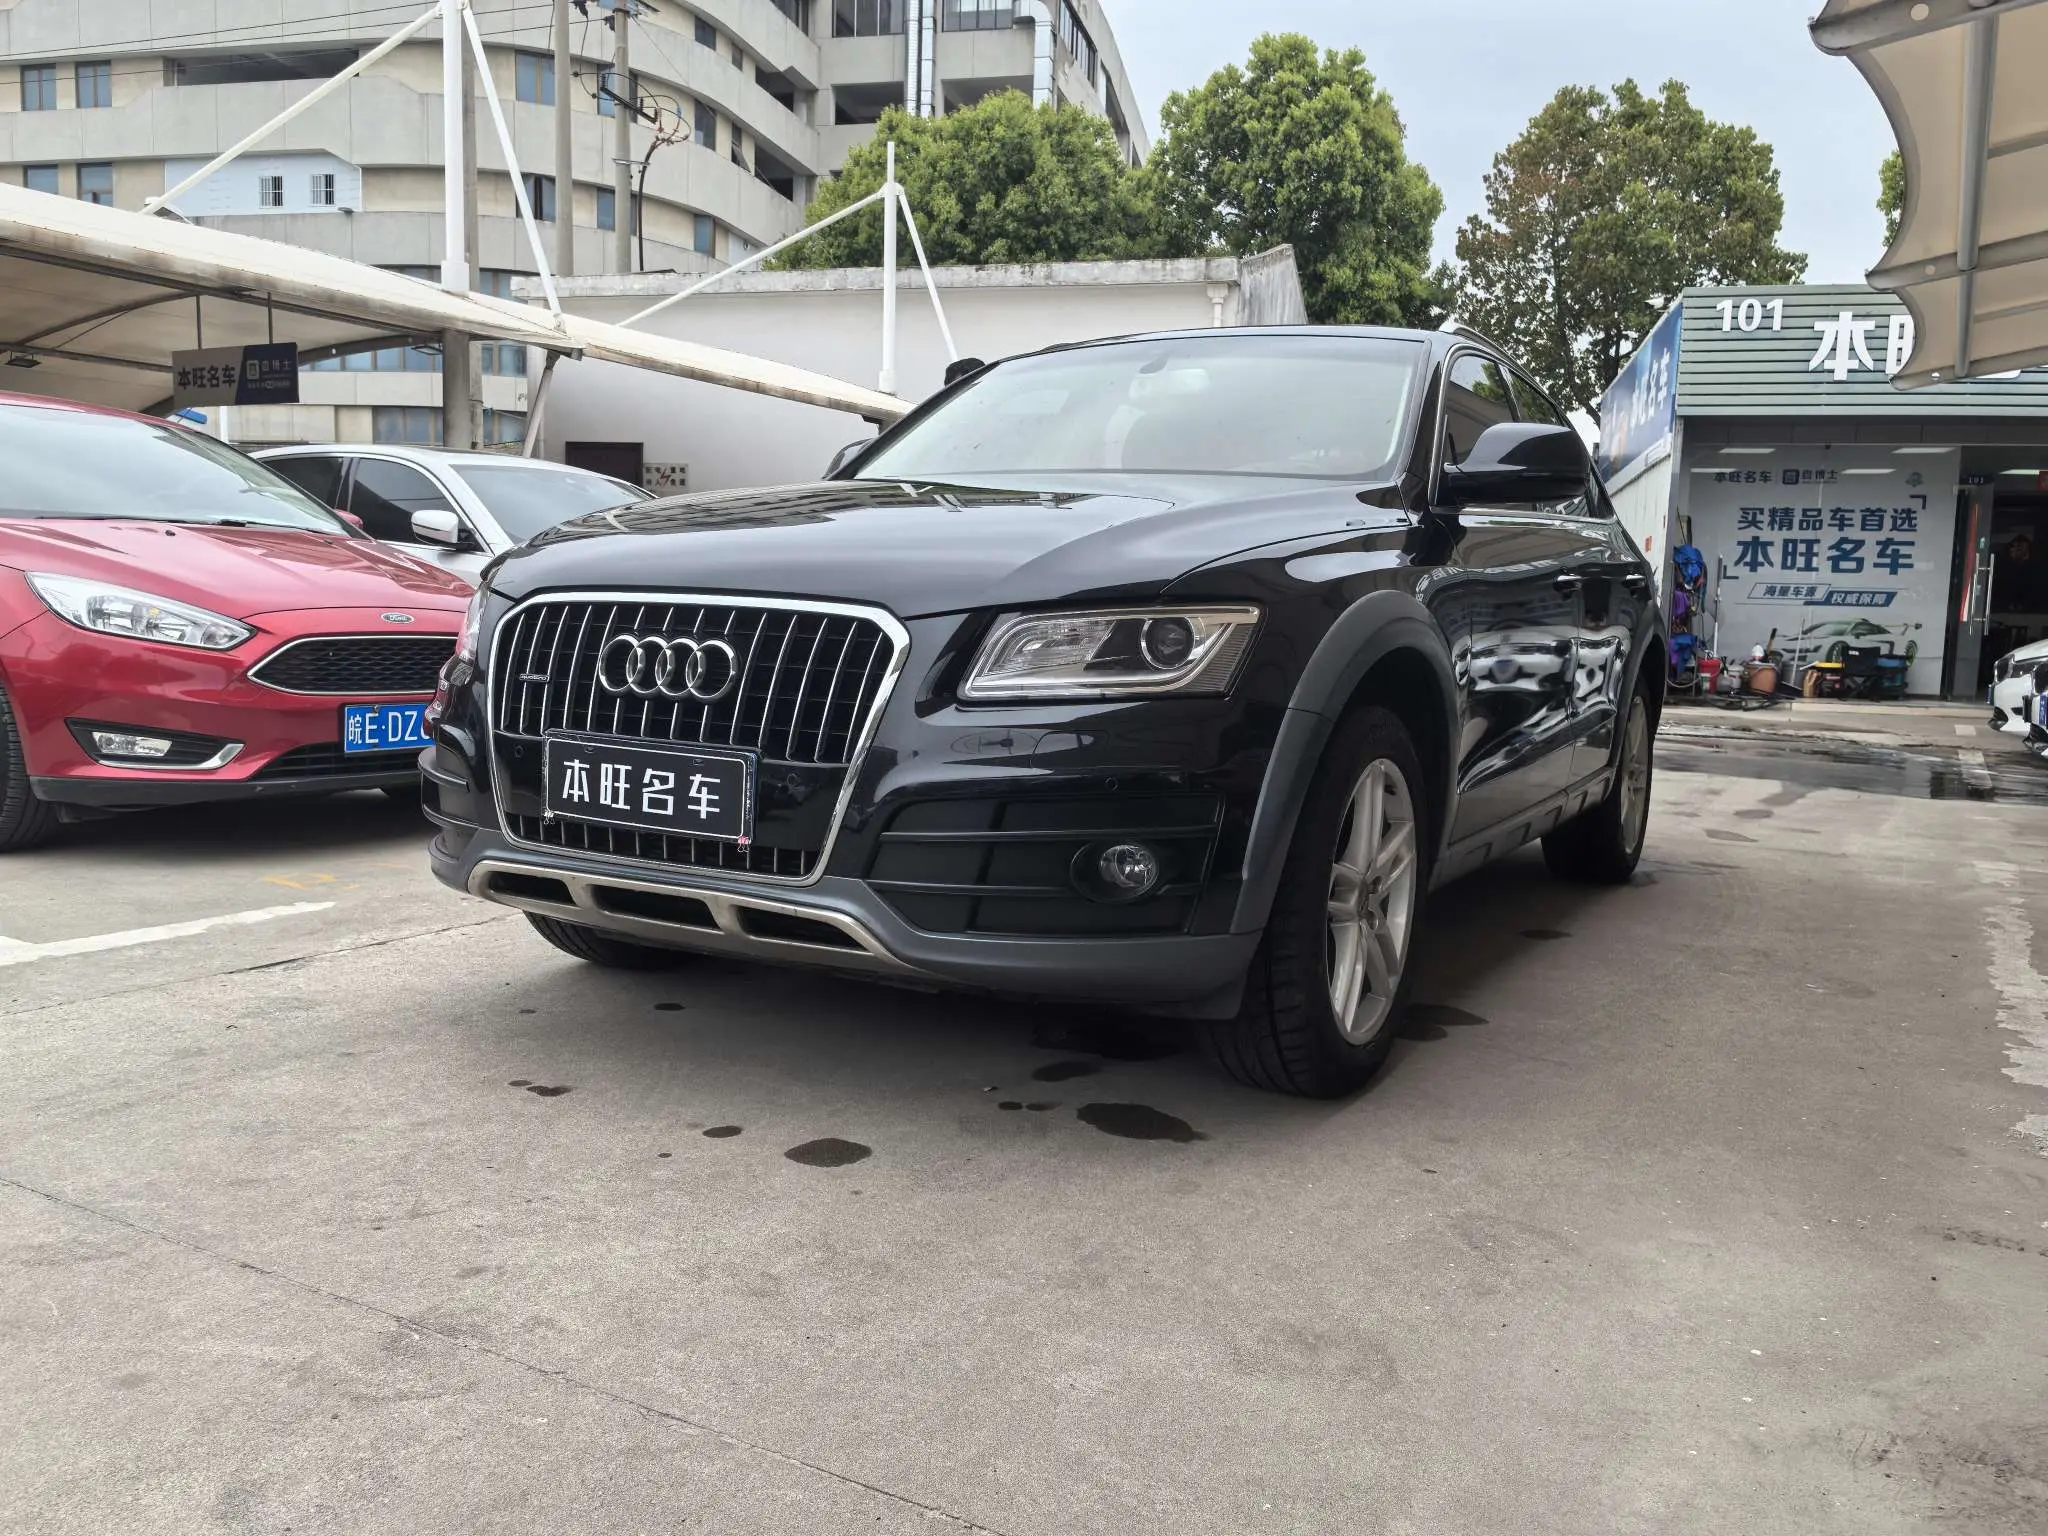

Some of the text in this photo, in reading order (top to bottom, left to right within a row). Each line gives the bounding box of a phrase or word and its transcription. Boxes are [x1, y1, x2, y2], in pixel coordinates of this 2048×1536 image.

[1716, 298, 1783, 332] 101
[177, 364, 236, 390] 本旺名车
[1714, 470, 1773, 483] 本旺名车
[1737, 507, 1918, 532] 买精品车首选
[1734, 535, 1916, 576] 本旺名车
[1763, 585, 1819, 597] 海量车源
[1831, 592, 1888, 605] 权威保障
[562, 759, 721, 820] 本旺名车
